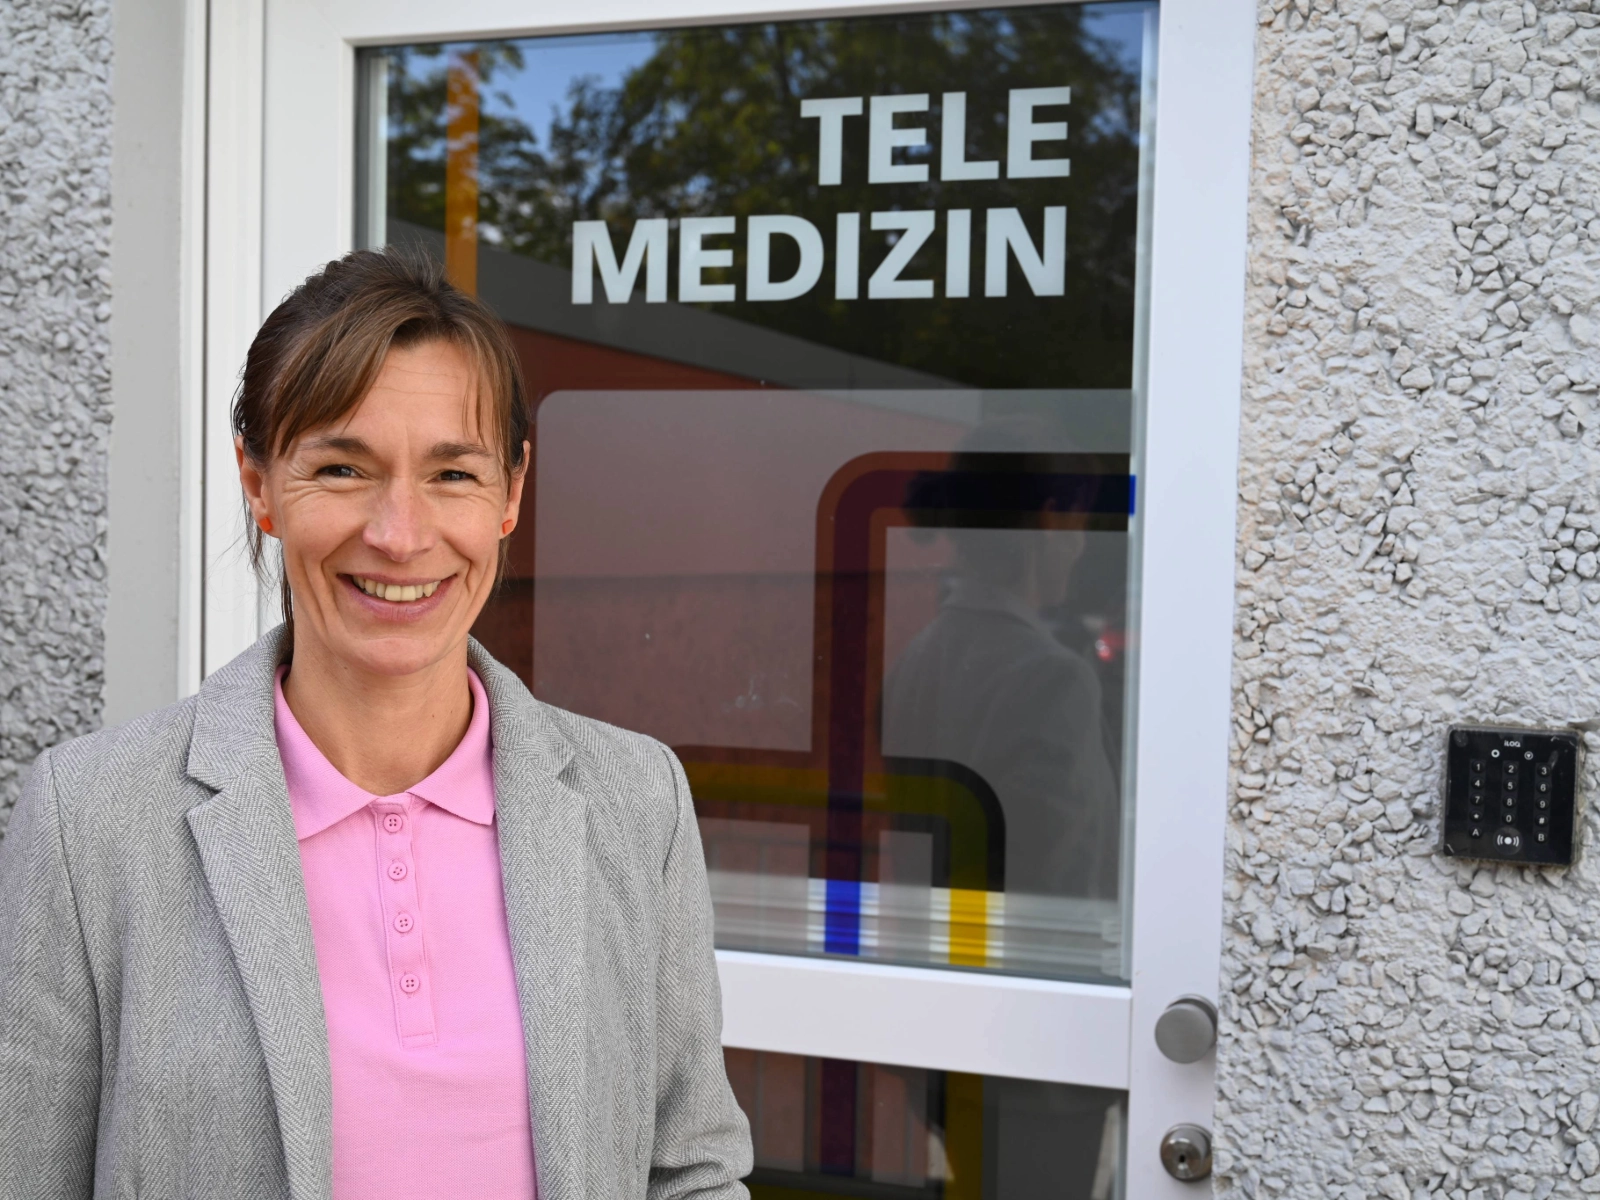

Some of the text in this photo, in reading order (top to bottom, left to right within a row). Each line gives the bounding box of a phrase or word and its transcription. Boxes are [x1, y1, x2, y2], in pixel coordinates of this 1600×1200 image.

[801, 86, 1071, 186] TELE
[571, 206, 1067, 305] MEDIZIN
[1475, 763, 1547, 775] 1 2 3
[1474, 779, 1546, 792] 4 5 6
[1474, 796, 1545, 808] 7 8 9
[1505, 815, 1511, 823] 0
[1538, 834, 1544, 842] B
